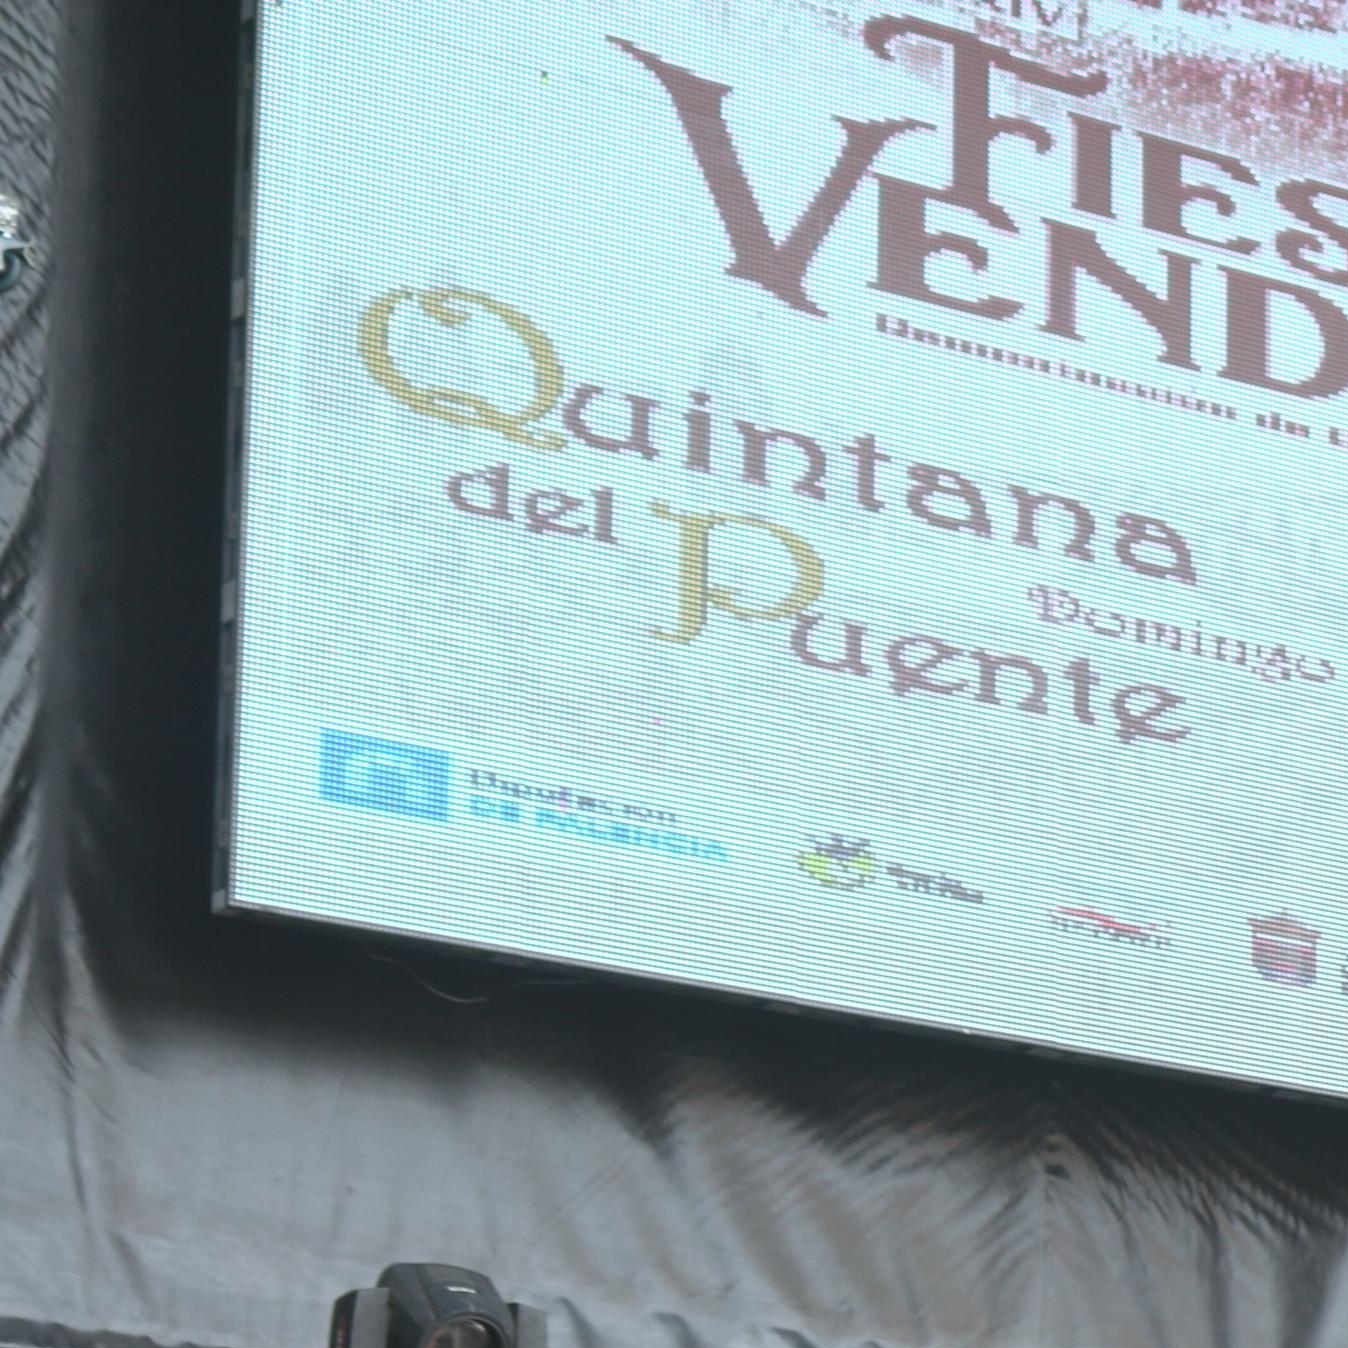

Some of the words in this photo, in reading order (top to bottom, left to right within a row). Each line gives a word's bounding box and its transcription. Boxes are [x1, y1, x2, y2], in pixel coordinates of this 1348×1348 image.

[357, 286, 1198, 586] Quintana
[445, 462, 619, 545] del
[645, 498, 1192, 745] Puente
[1026, 584, 1336, 684] Domingo
